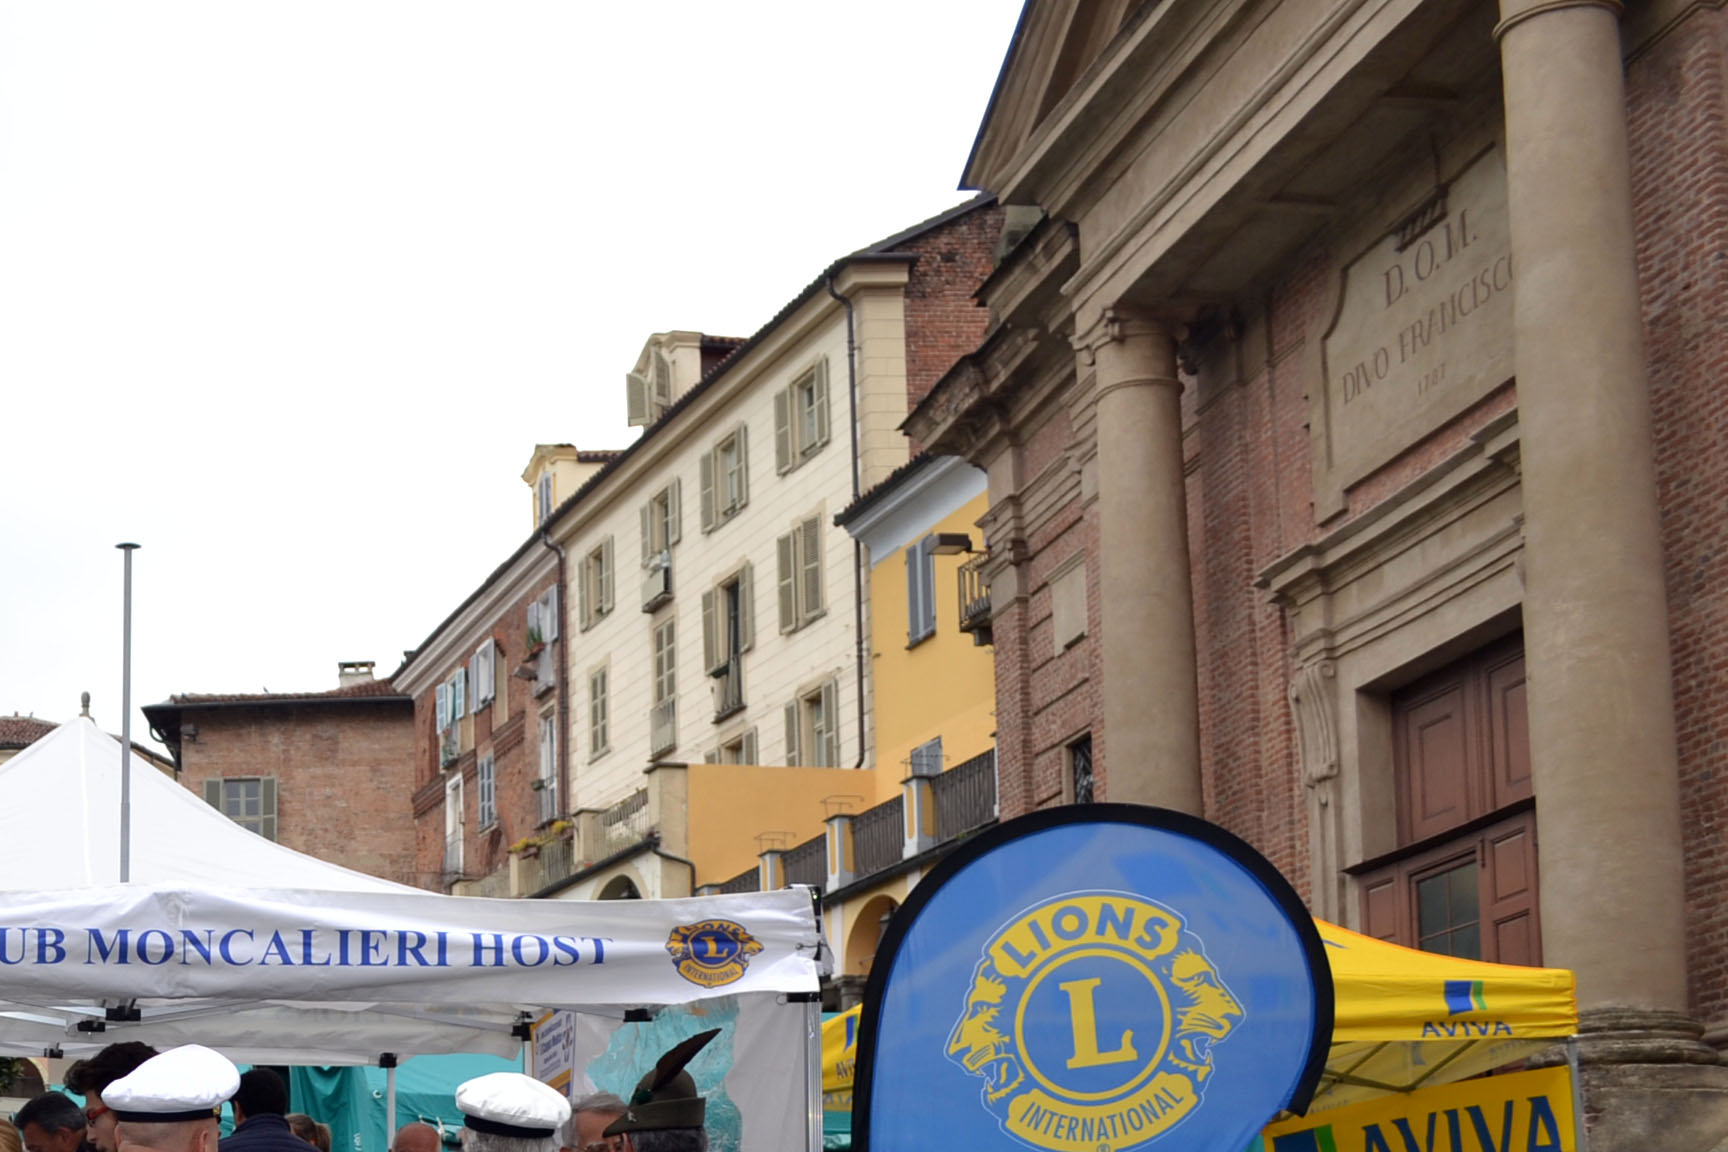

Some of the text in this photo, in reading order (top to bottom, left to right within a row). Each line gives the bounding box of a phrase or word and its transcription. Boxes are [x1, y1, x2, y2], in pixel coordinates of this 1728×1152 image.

[1342, 253, 1513, 405] DIVO FRANCISC
[84, 927, 452, 967] MONCALIERI
[467, 932, 615, 967] HOST
[701, 936, 728, 957] L
[1001, 903, 1169, 969] LIONS
[1059, 977, 1138, 1069] L
[1422, 1020, 1513, 1037] AVIVA
[1019, 1086, 1184, 1142] INTERNATIONAL
